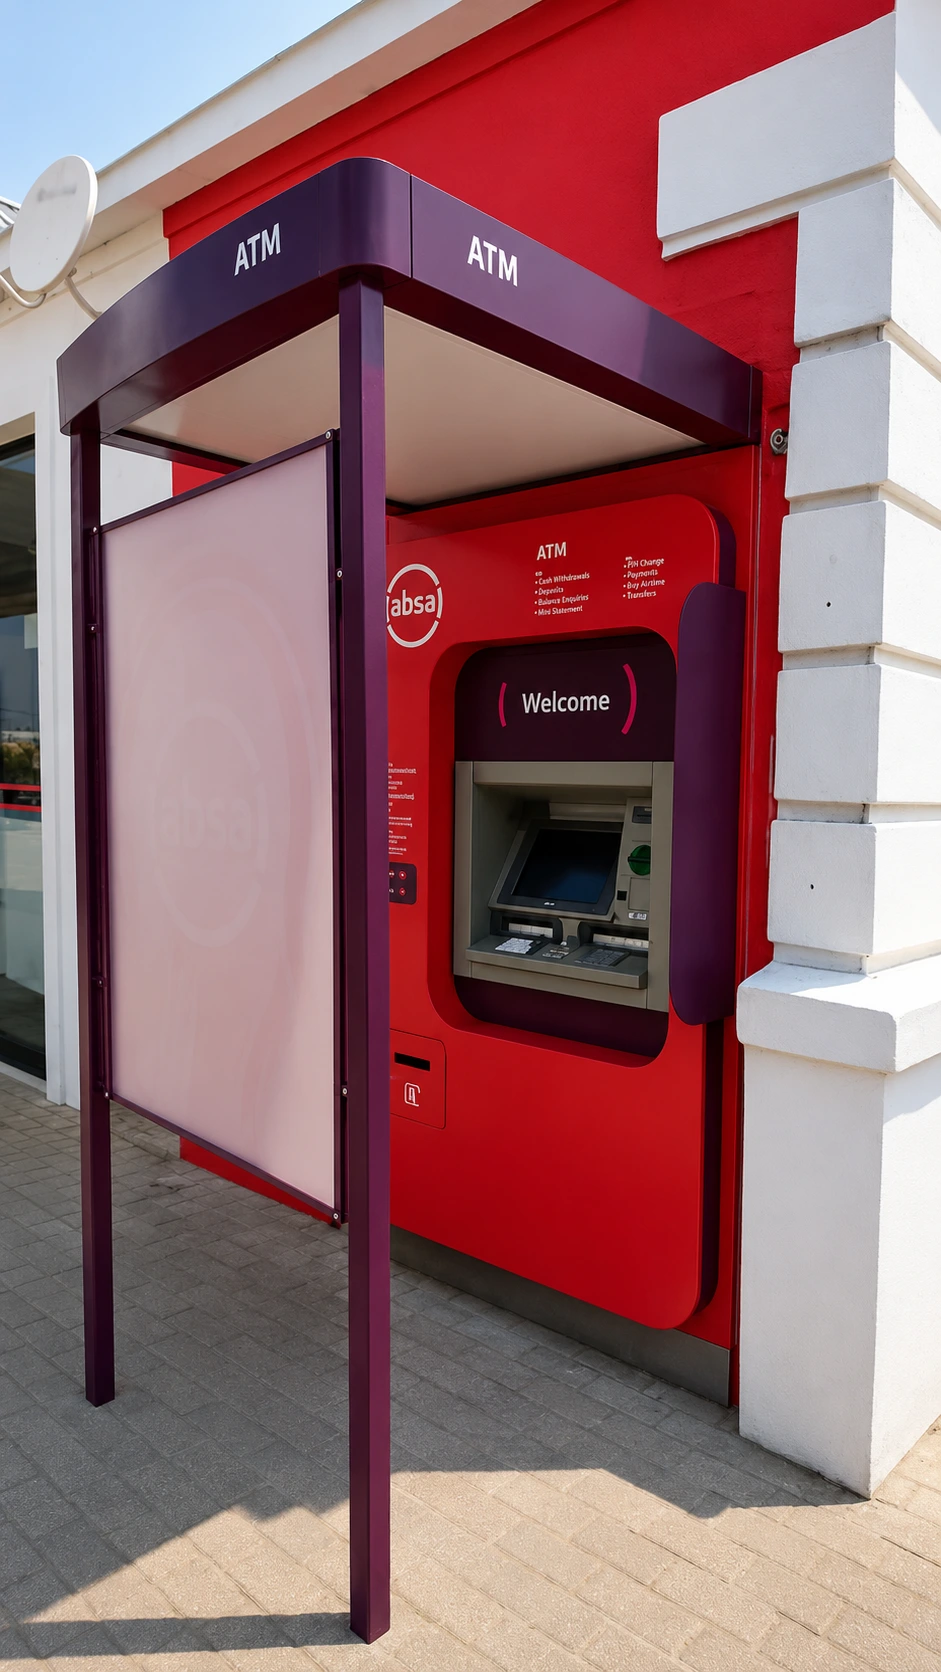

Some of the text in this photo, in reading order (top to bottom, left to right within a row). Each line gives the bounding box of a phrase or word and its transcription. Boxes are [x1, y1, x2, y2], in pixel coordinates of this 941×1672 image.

[234, 223, 281, 276] ATM
[467, 235, 518, 287] ATM
[536, 542, 567, 560] ATM
[639, 558, 665, 567] Change
[538, 577, 553, 585] Cash
[553, 572, 590, 583] Withdrawals
[627, 569, 658, 580] Payments
[627, 578, 666, 590] Buy Airtime
[561, 594, 589, 604] Enquiries
[627, 589, 657, 599] Transfers
[390, 590, 436, 617] absa
[552, 605, 583, 615] Statement
[521, 691, 610, 714] Welcome
